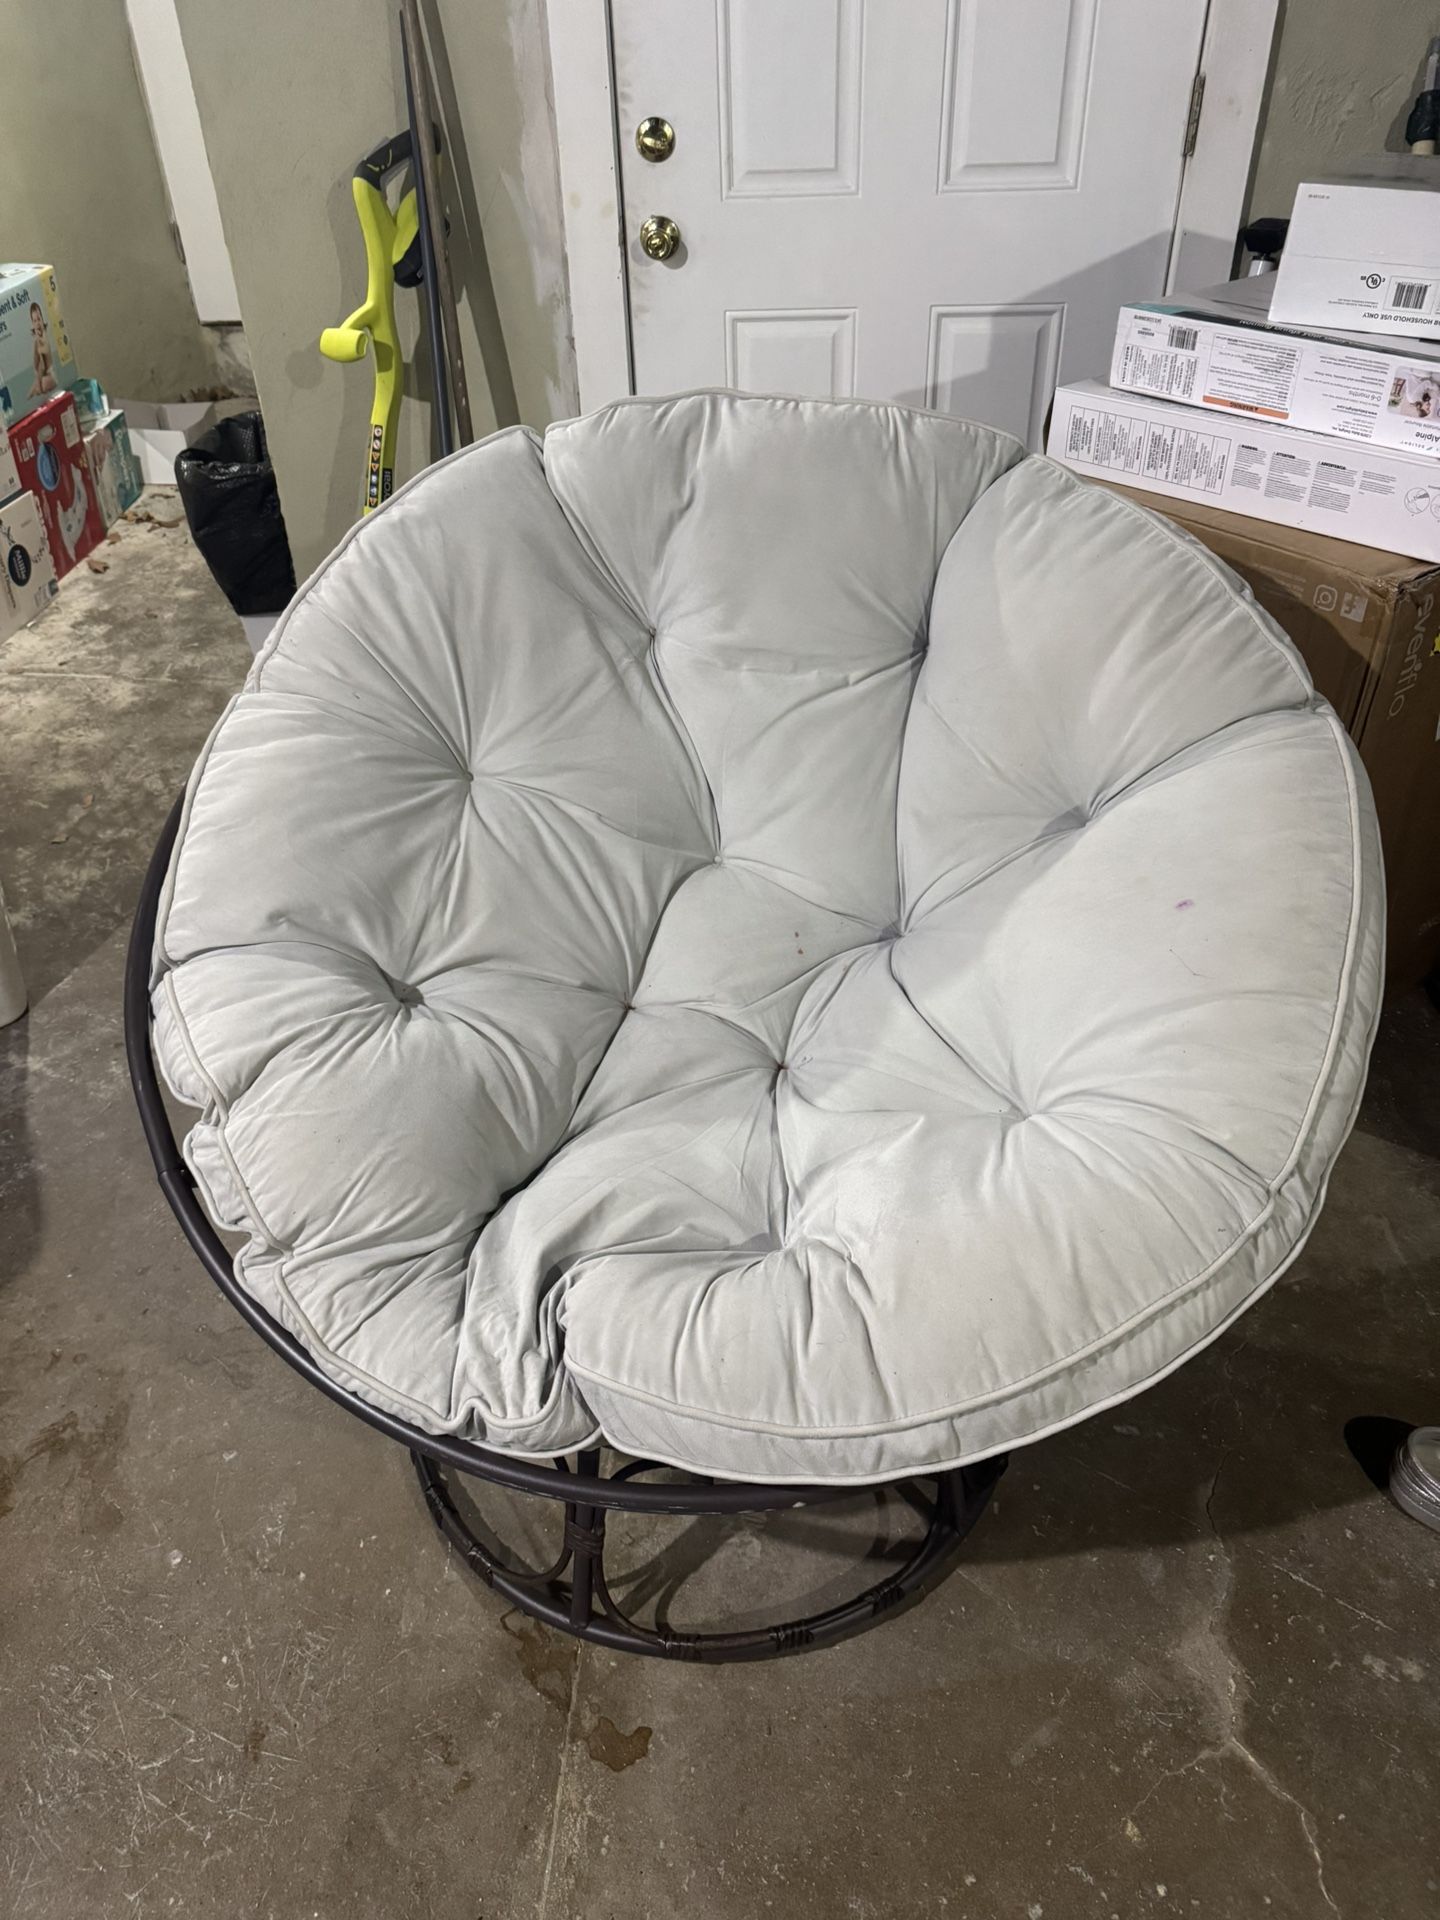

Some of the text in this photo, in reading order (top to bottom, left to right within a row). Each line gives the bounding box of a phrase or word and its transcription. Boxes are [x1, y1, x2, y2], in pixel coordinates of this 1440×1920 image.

[16, 289, 30, 306] Soft
[1380, 313, 1393, 321] USE
[1393, 315, 1433, 325] HOUSEHOLD
[1415, 431, 1440, 442] Alpine
[383, 470, 391, 500] YOBI
[1388, 592, 1434, 718] evenflo
